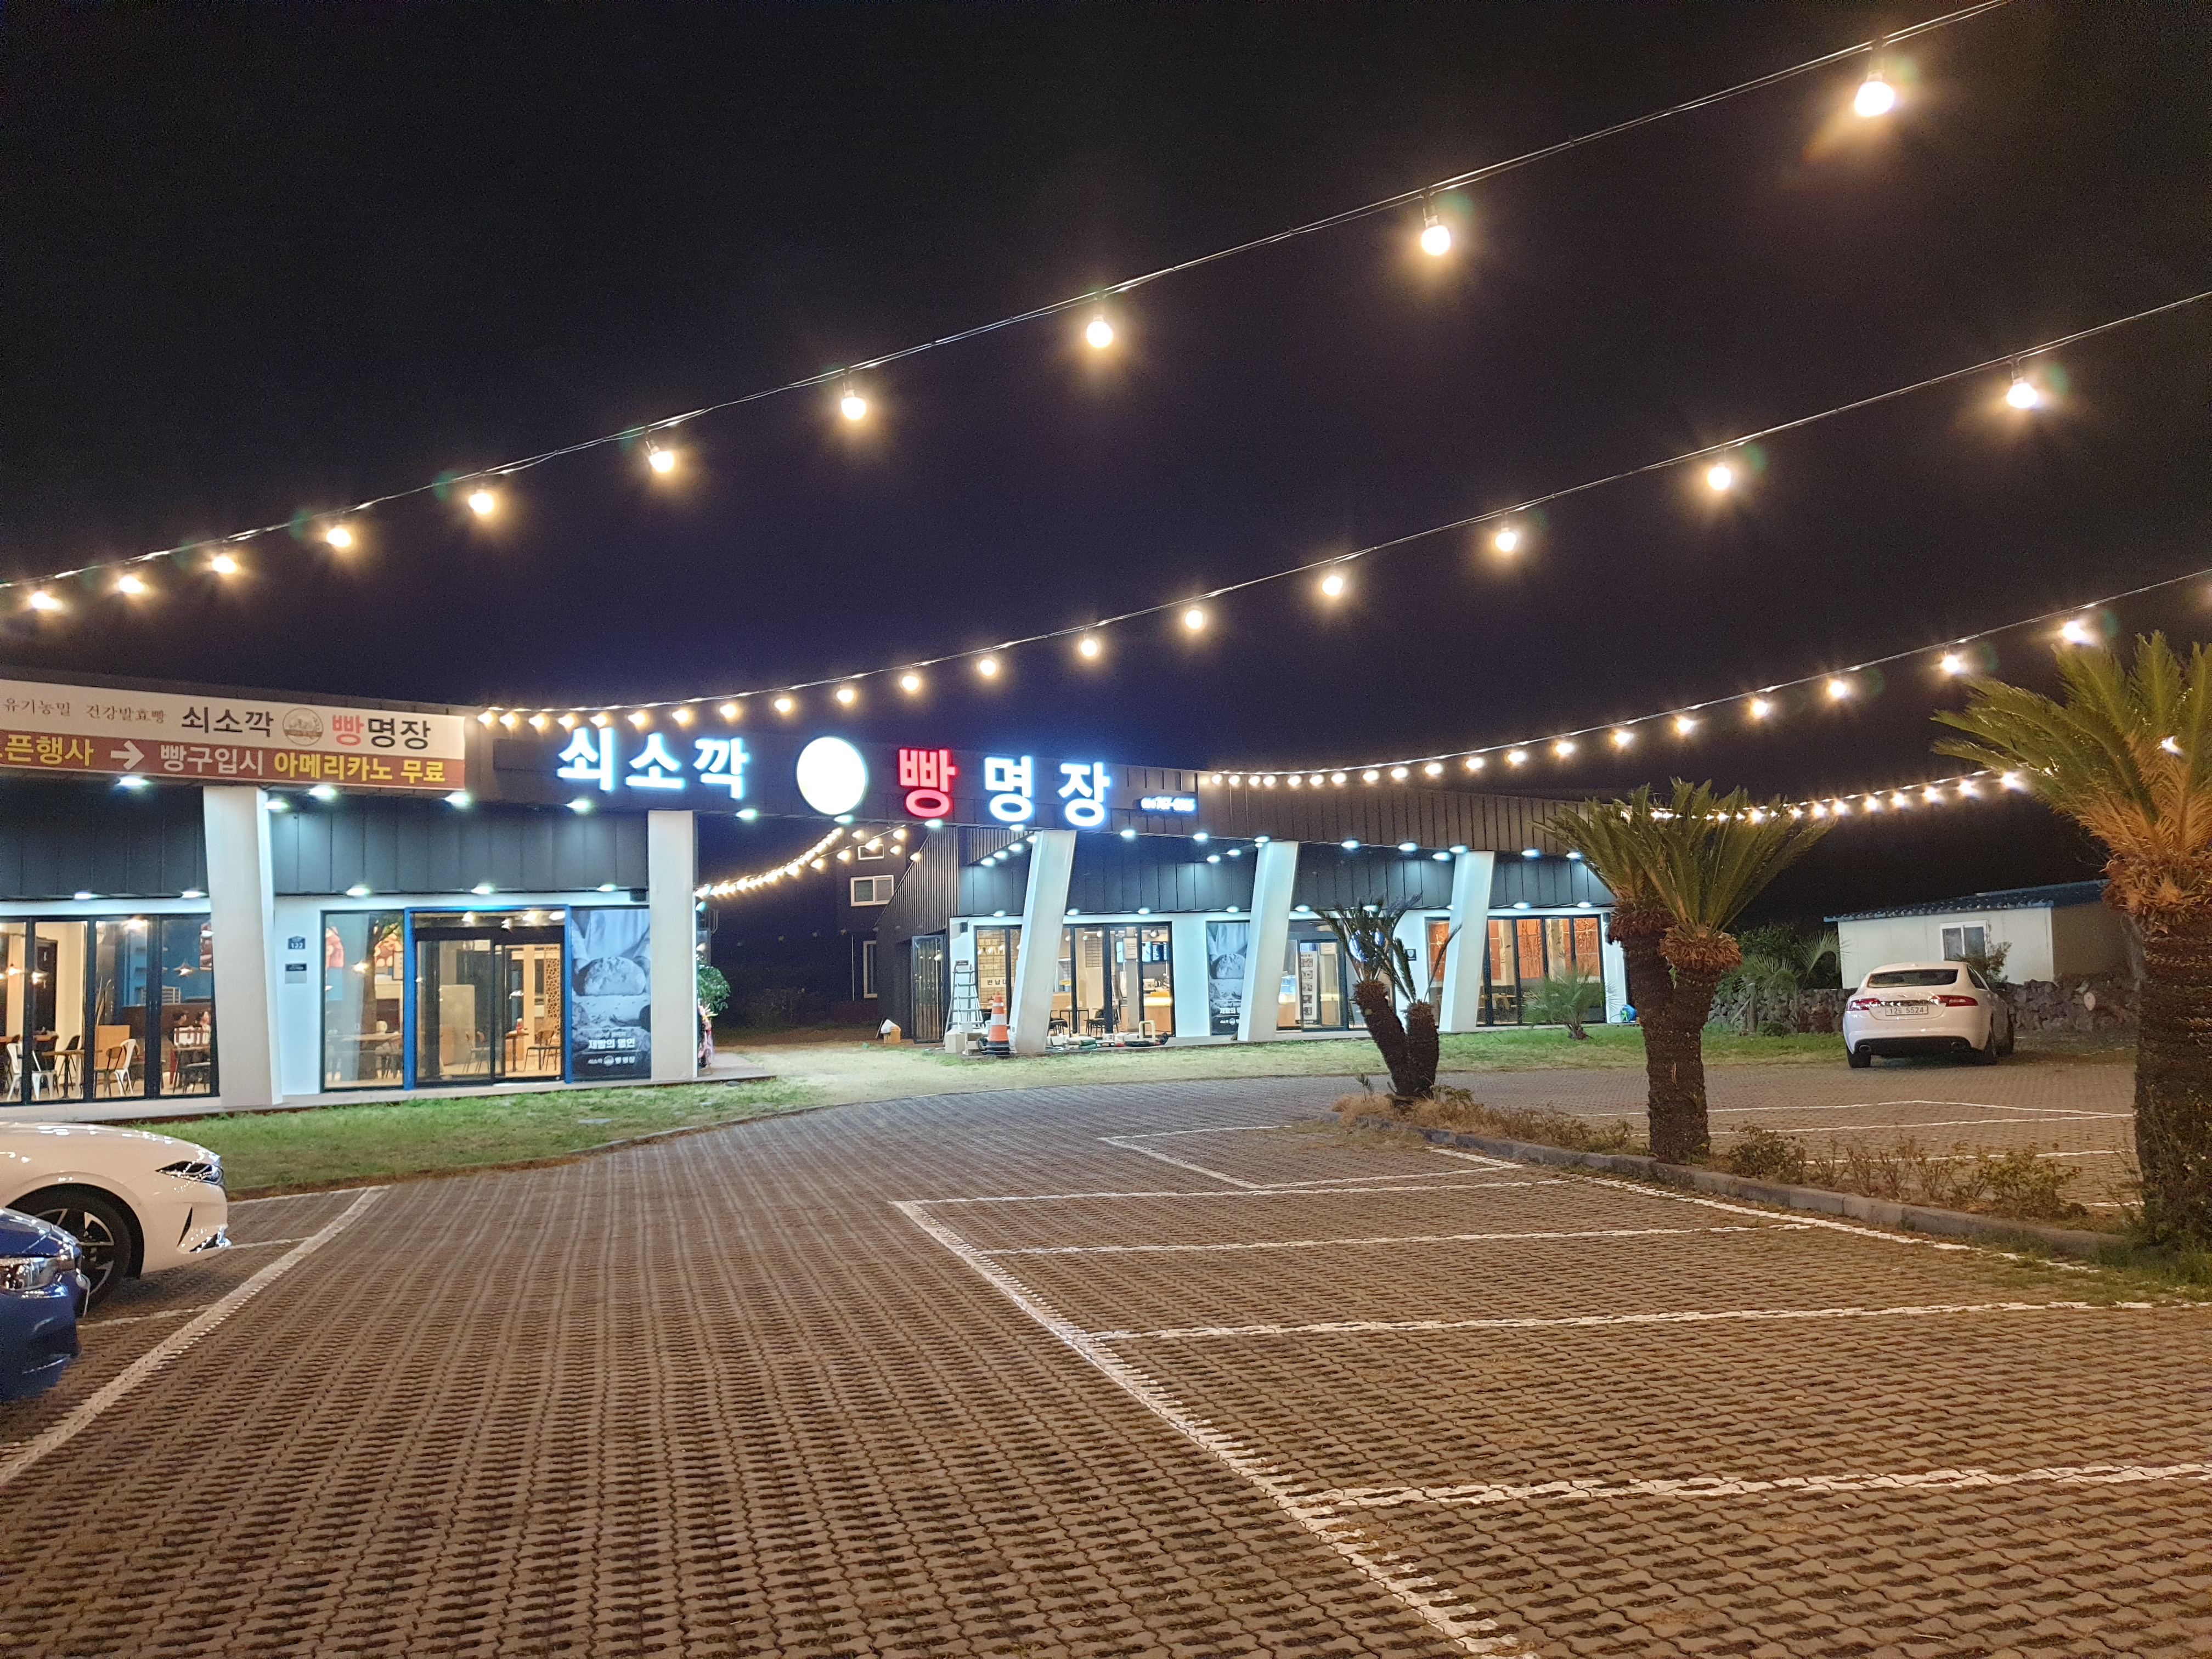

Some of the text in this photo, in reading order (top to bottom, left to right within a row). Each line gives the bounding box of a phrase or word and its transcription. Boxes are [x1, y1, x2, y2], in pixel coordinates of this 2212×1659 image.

[3, 697, 71, 716] 유기농밀
[182, 706, 274, 738] 쇠소깍
[332, 714, 431, 750] 빵명장
[0, 734, 446, 784] 픈행사 빵구입시 아메리카노 무료
[557, 727, 751, 799] 쇠소깍
